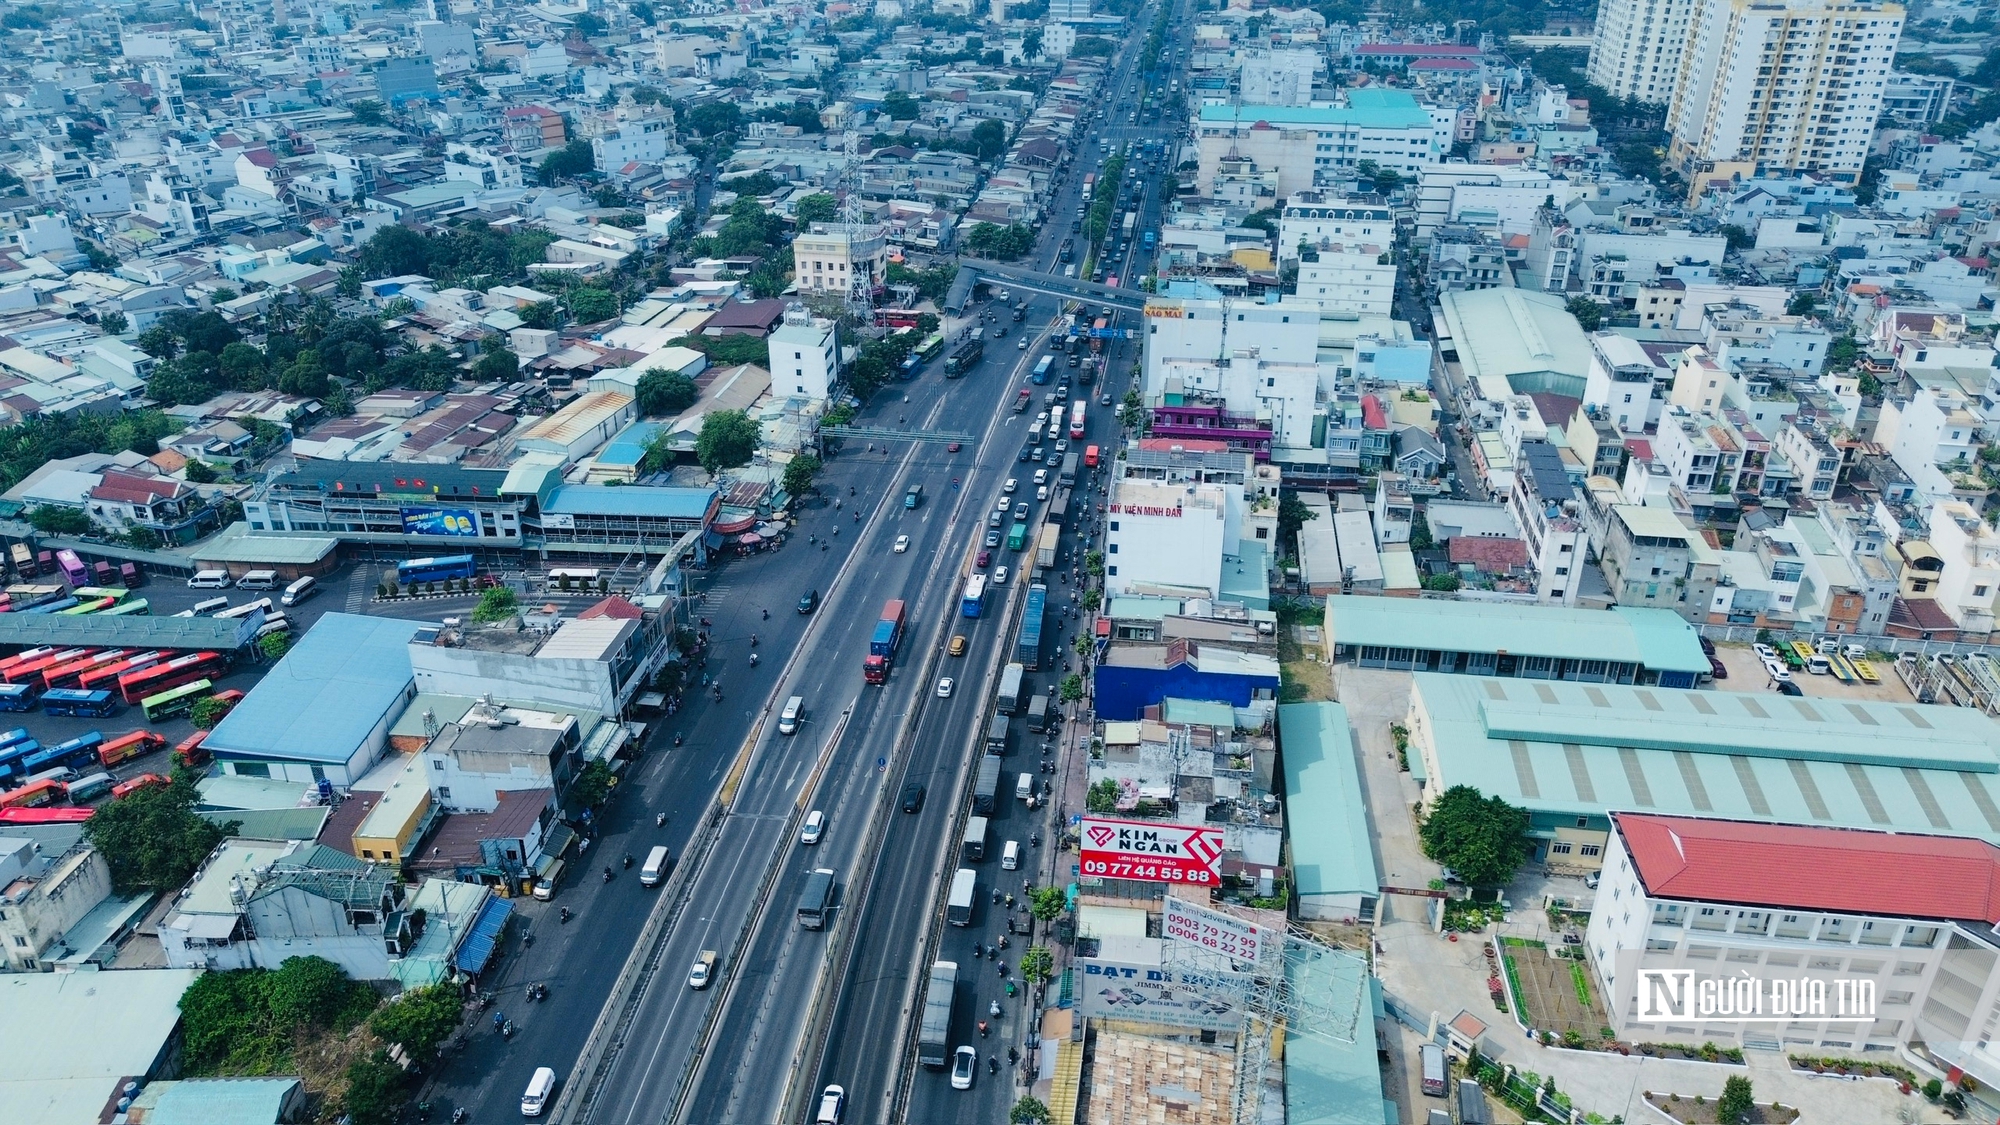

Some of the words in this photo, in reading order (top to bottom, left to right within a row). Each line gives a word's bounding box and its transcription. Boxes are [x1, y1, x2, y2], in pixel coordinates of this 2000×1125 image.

[1164, 310, 1182, 318] MAI
[1109, 502, 1122, 513] MỸ
[1124, 503, 1142, 516] VIỆN
[1143, 506, 1164, 516] MINH
[1119, 828, 1157, 841] KIM
[1119, 840, 1177, 854] NGAN
[1118, 855, 1131, 863] LIÊN
[1084, 861, 1107, 873] 09
[1110, 862, 1132, 875] 77
[1134, 865, 1156, 877] 44
[1160, 867, 1183, 880] 55
[1186, 869, 1209, 882] 88
[1168, 913, 1199, 930] 0903
[1202, 924, 1218, 936] 79
[1221, 930, 1237, 942] 77
[1240, 937, 1256, 948] 99
[1167, 925, 1199, 942] 0906
[1201, 936, 1217, 948] 68
[1220, 942, 1236, 954] 22
[1239, 948, 1255, 960] 22
[1085, 964, 1138, 980] BẠT
[1135, 981, 1165, 990] JIMMY
